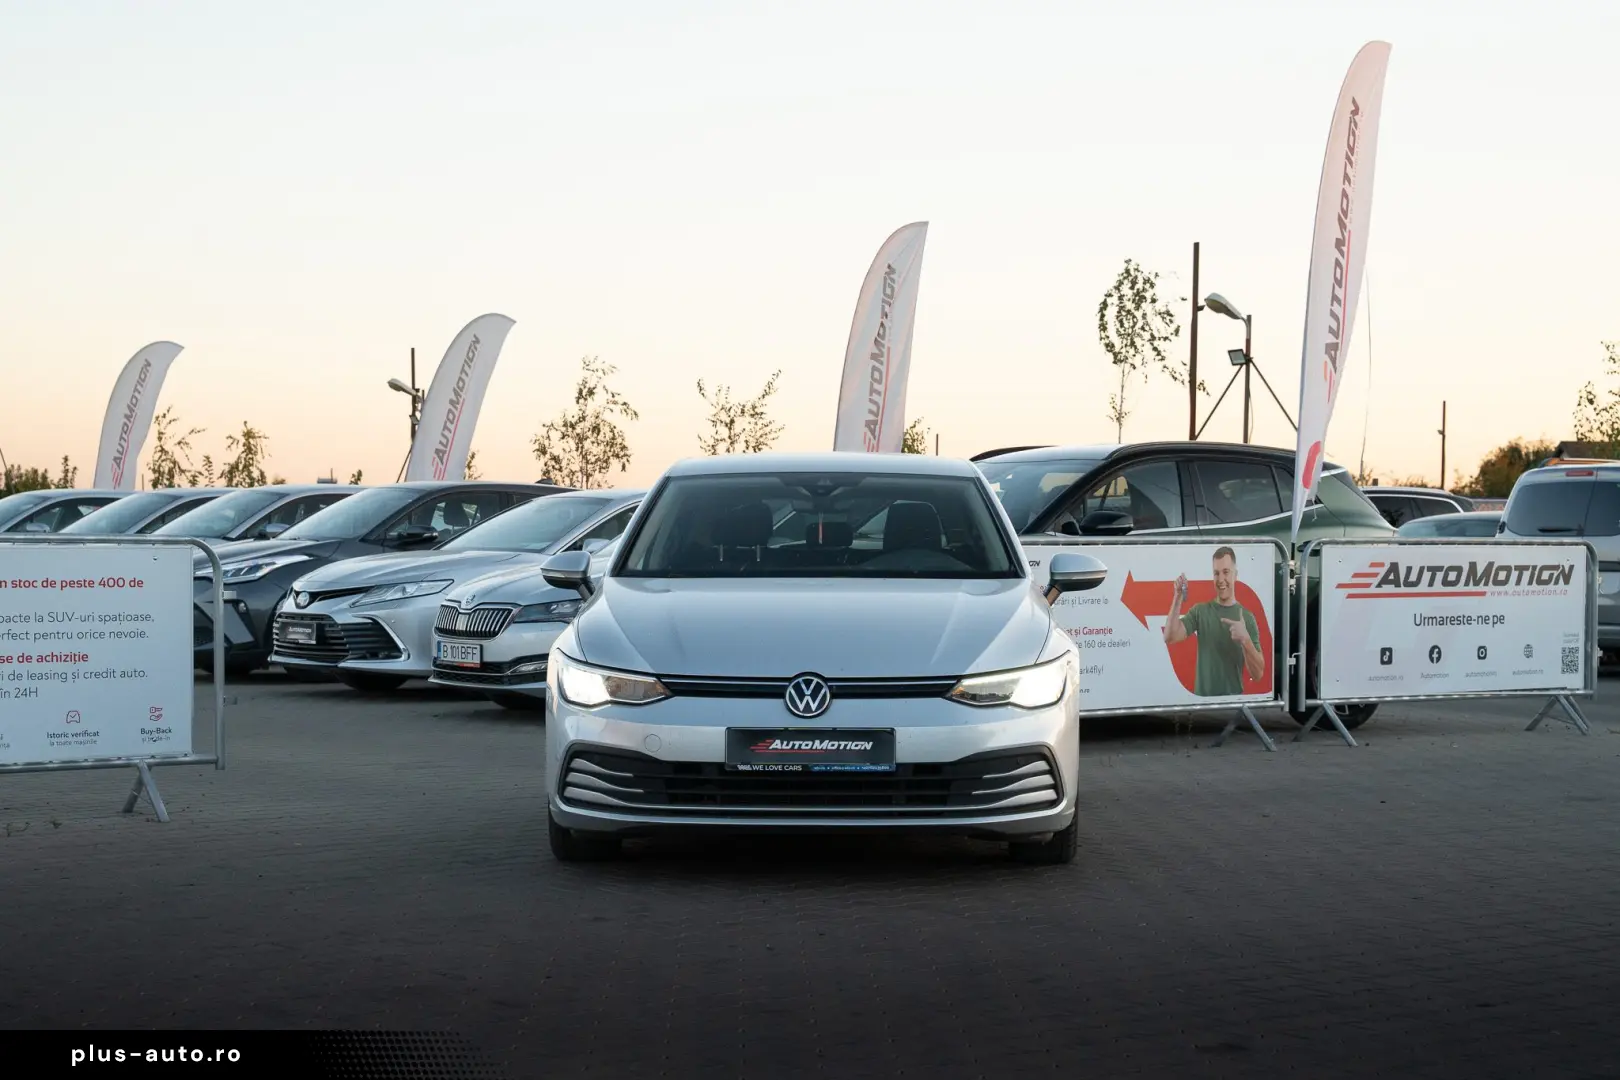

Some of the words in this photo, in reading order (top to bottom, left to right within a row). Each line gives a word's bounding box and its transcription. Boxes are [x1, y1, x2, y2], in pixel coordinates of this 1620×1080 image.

[1374, 561, 1574, 588] AUTOMOTION
[11, 578, 38, 589] stoc
[41, 577, 57, 589] de
[60, 578, 95, 591] peste
[98, 577, 126, 588] 400
[128, 577, 144, 588] de
[1078, 596, 1102, 605] Livrare
[34, 611, 44, 623] la
[47, 611, 95, 623] SUV-uri
[1413, 612, 1490, 627] Urmareste-ne
[1492, 613, 1505, 628] pe
[0, 628, 30, 641] rfect
[33, 630, 73, 643] pentru
[76, 628, 106, 640] orice
[108, 627, 149, 639] nevoie.
[1084, 639, 1096, 649] 160
[1097, 639, 1107, 648] de
[0, 655, 13, 664] se
[17, 652, 33, 663] de
[36, 651, 89, 665] achiziție
[443, 644, 449, 658] B
[450, 645, 460, 659] 101
[460, 645, 478, 660] BFF
[8, 669, 23, 681] de
[26, 669, 68, 683] leasing
[83, 668, 116, 680] credit
[120, 667, 148, 679] auto.
[1079, 664, 1104, 676] ark4fly!
[14, 686, 38, 699] 24H
[46, 731, 69, 739] Istoric
[70, 729, 100, 739] verificat
[140, 726, 173, 737] Buy-Back
[768, 739, 874, 750] AUTOMOTION
